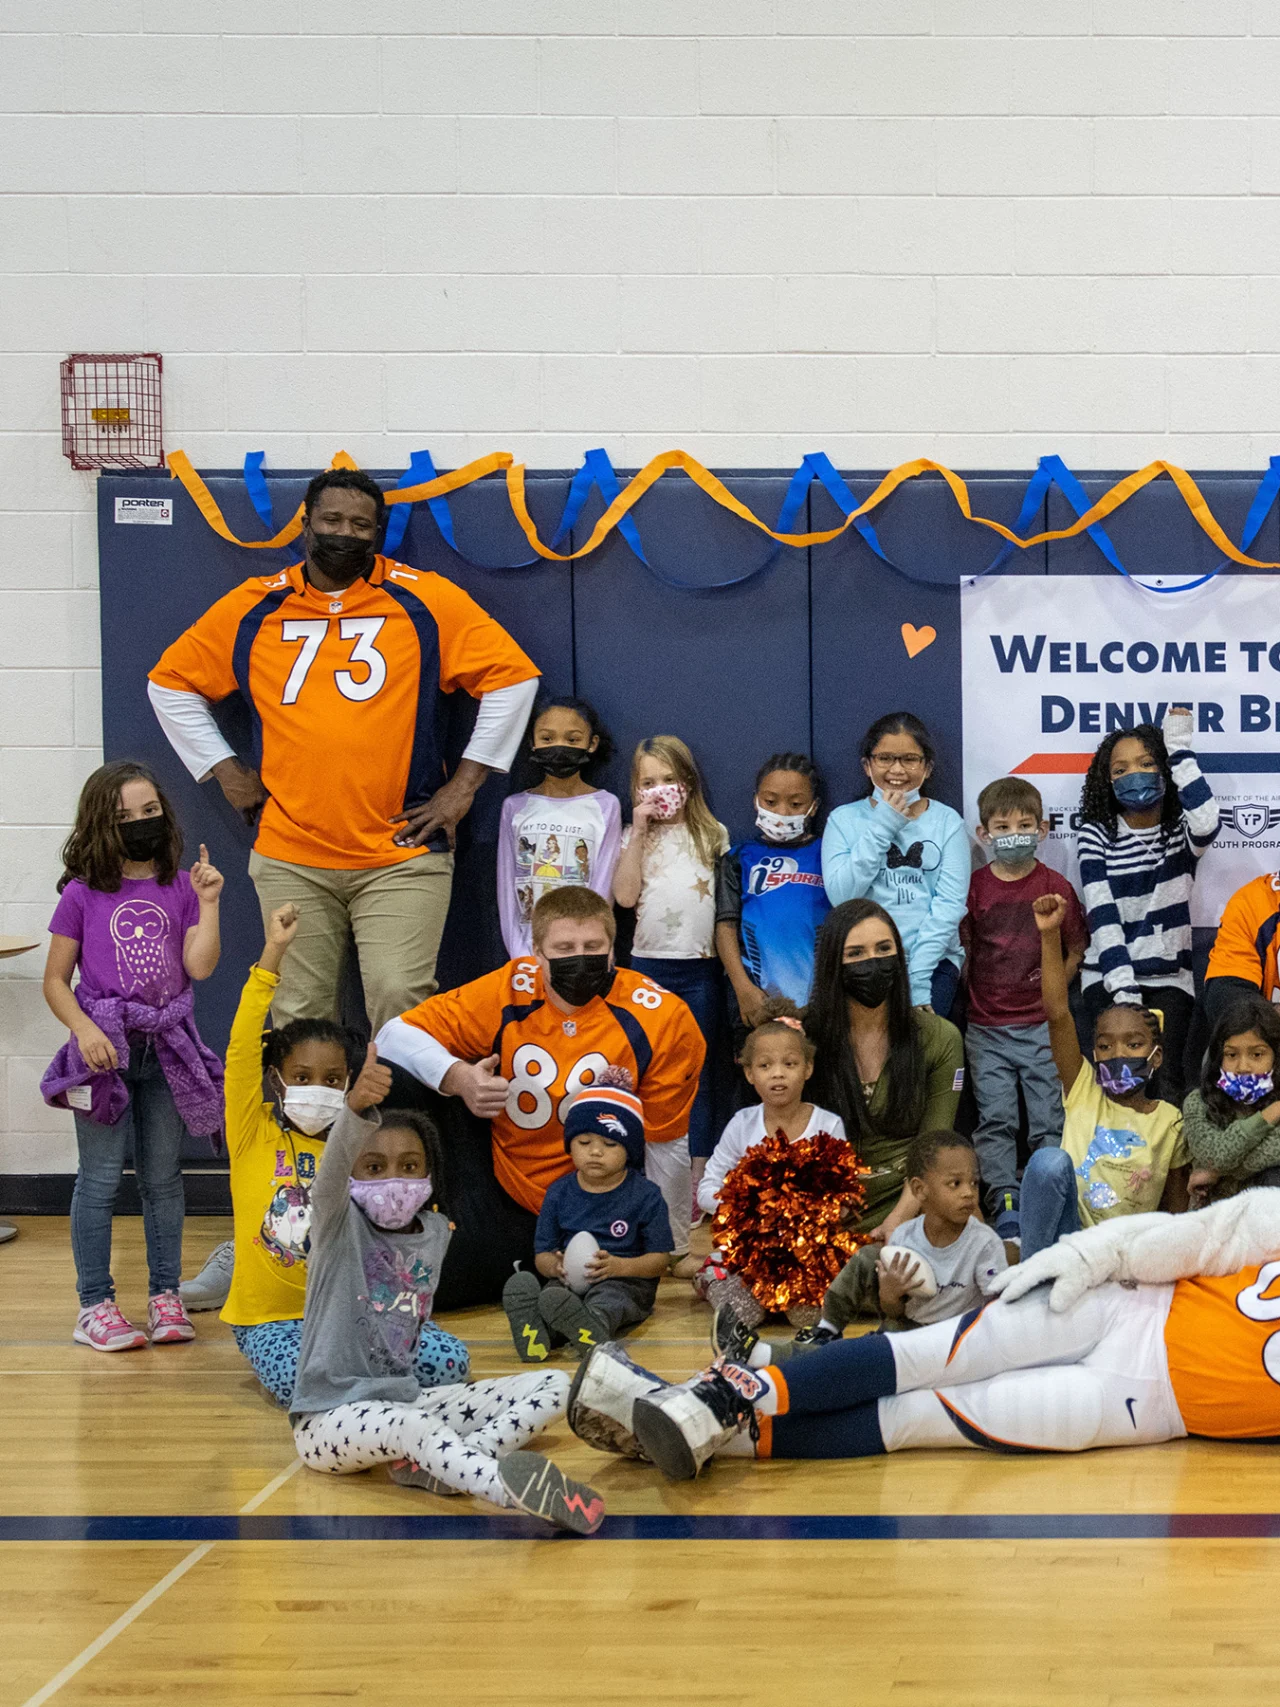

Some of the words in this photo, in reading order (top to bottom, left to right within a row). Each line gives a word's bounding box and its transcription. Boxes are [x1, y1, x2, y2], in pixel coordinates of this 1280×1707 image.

[101, 425, 128, 433] ALERT
[280, 616, 388, 706] 73
[989, 634, 1227, 674] WELCOME
[1041, 694, 1225, 734] DENVR
[536, 823, 547, 831] TO
[549, 824, 563, 832] DO
[1241, 813, 1262, 826] YP
[996, 833, 1032, 849] myles
[1211, 841, 1239, 849] OUTH
[274, 1150, 316, 1179] LO
